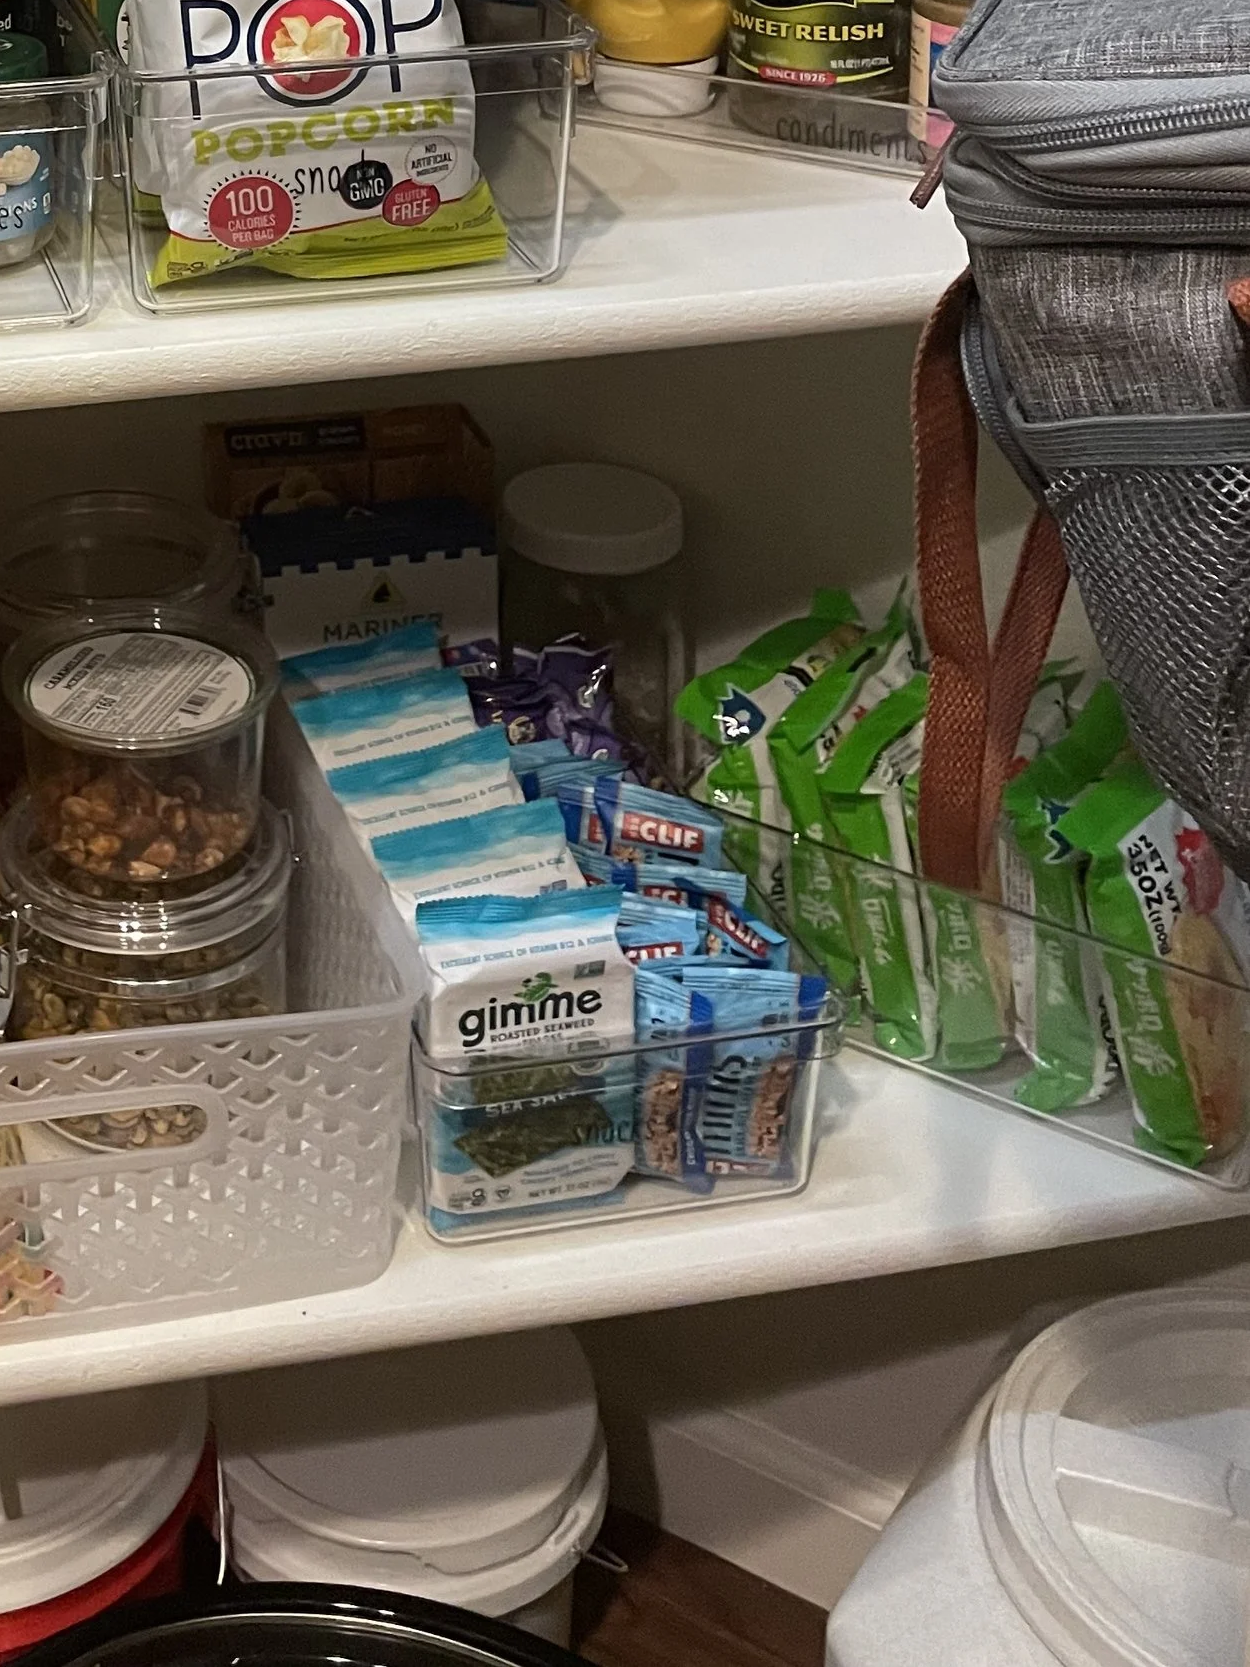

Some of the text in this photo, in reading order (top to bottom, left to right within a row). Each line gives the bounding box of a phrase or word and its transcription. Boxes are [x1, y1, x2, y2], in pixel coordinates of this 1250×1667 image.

[732, 11, 885, 43] SWEET RELISH
[765, 70, 827, 83] SINCE 1926
[191, 97, 456, 166] POPCORN
[776, 111, 927, 165] condiments
[410, 151, 453, 171] ARTIFICIAL
[424, 143, 437, 154] NO
[225, 185, 274, 217] 100
[350, 177, 385, 202] GMO
[394, 189, 428, 205] GLUTEN
[227, 213, 276, 232] CALORIES
[392, 199, 431, 221] FREE
[232, 227, 274, 243] PER BAG
[639, 820, 699, 849] CLIF
[1138, 834, 1169, 875] NET
[458, 988, 603, 1049] gimme
[489, 1017, 595, 1044] ROASTED SEAWEED
[485, 1101, 524, 1118] SEA
